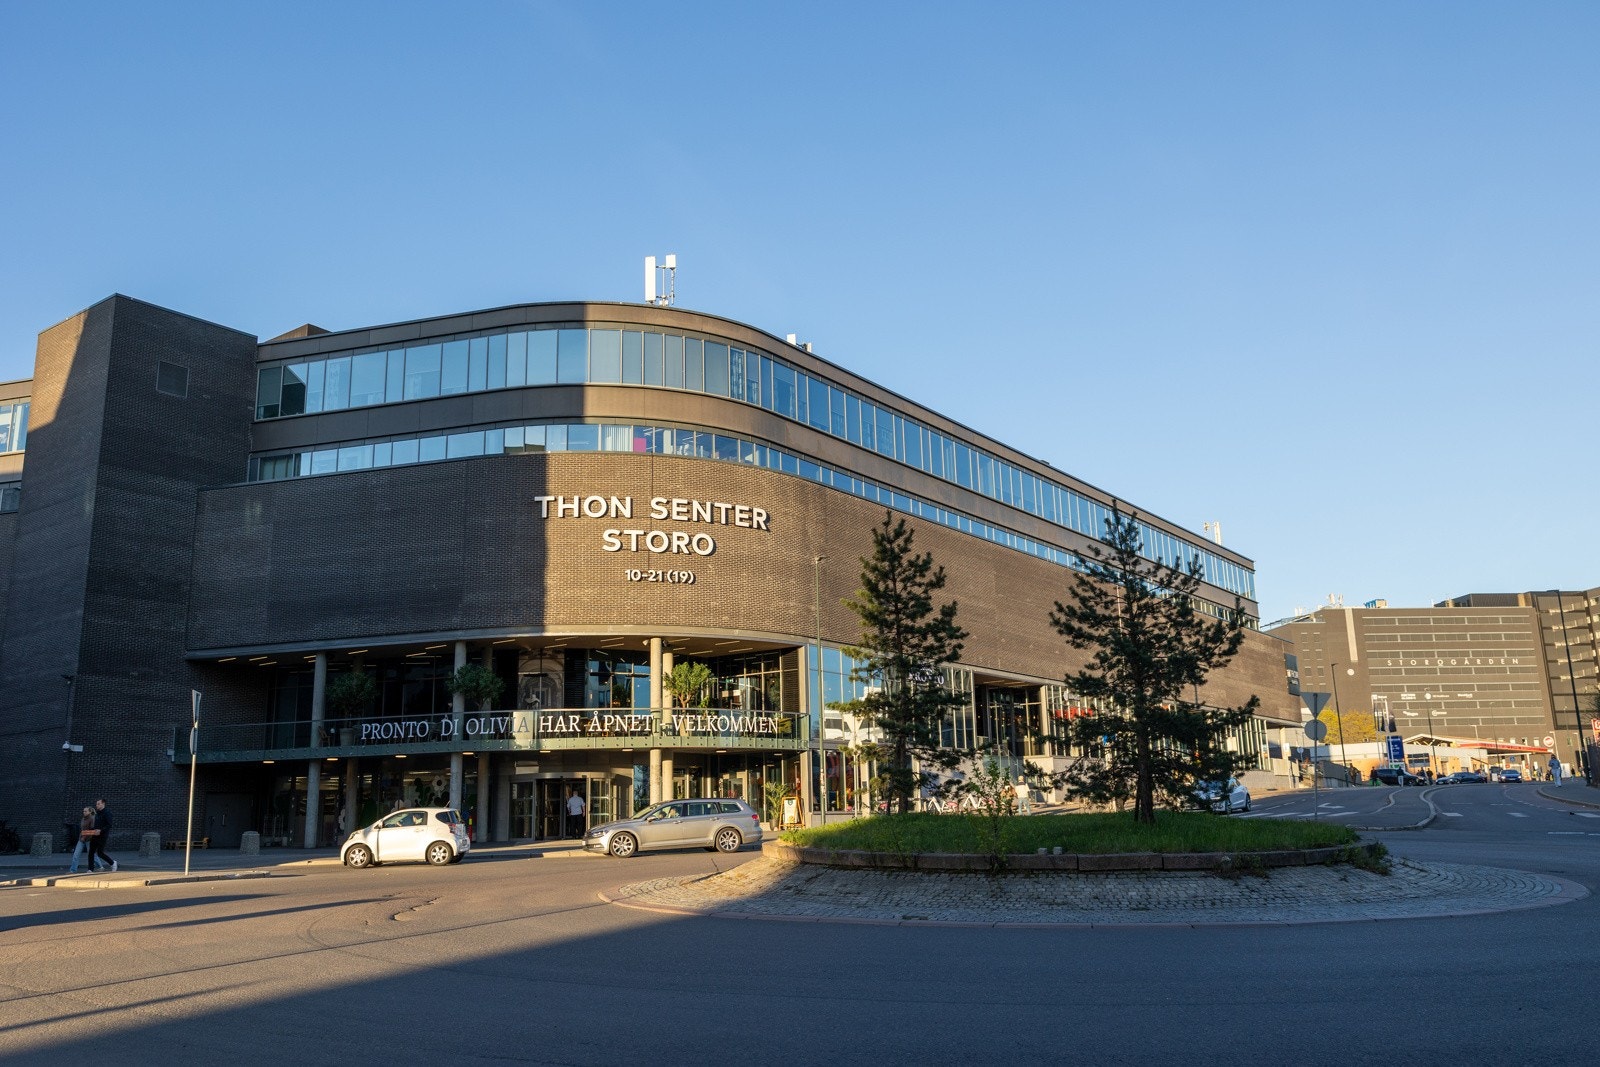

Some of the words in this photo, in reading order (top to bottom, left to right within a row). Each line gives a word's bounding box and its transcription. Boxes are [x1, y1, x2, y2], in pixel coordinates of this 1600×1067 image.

[534, 495, 632, 519] THON
[650, 496, 769, 530] SENTER
[602, 529, 715, 556] STORO
[624, 569, 663, 582] 10-21
[666, 569, 695, 584] (19)
[361, 721, 429, 740] PRONTO
[441, 718, 459, 736] DI
[466, 716, 531, 735] OLIVIA
[538, 715, 581, 733] HAR
[588, 711, 654, 732] ÅPNET
[672, 714, 778, 733] VELKOMMEN
